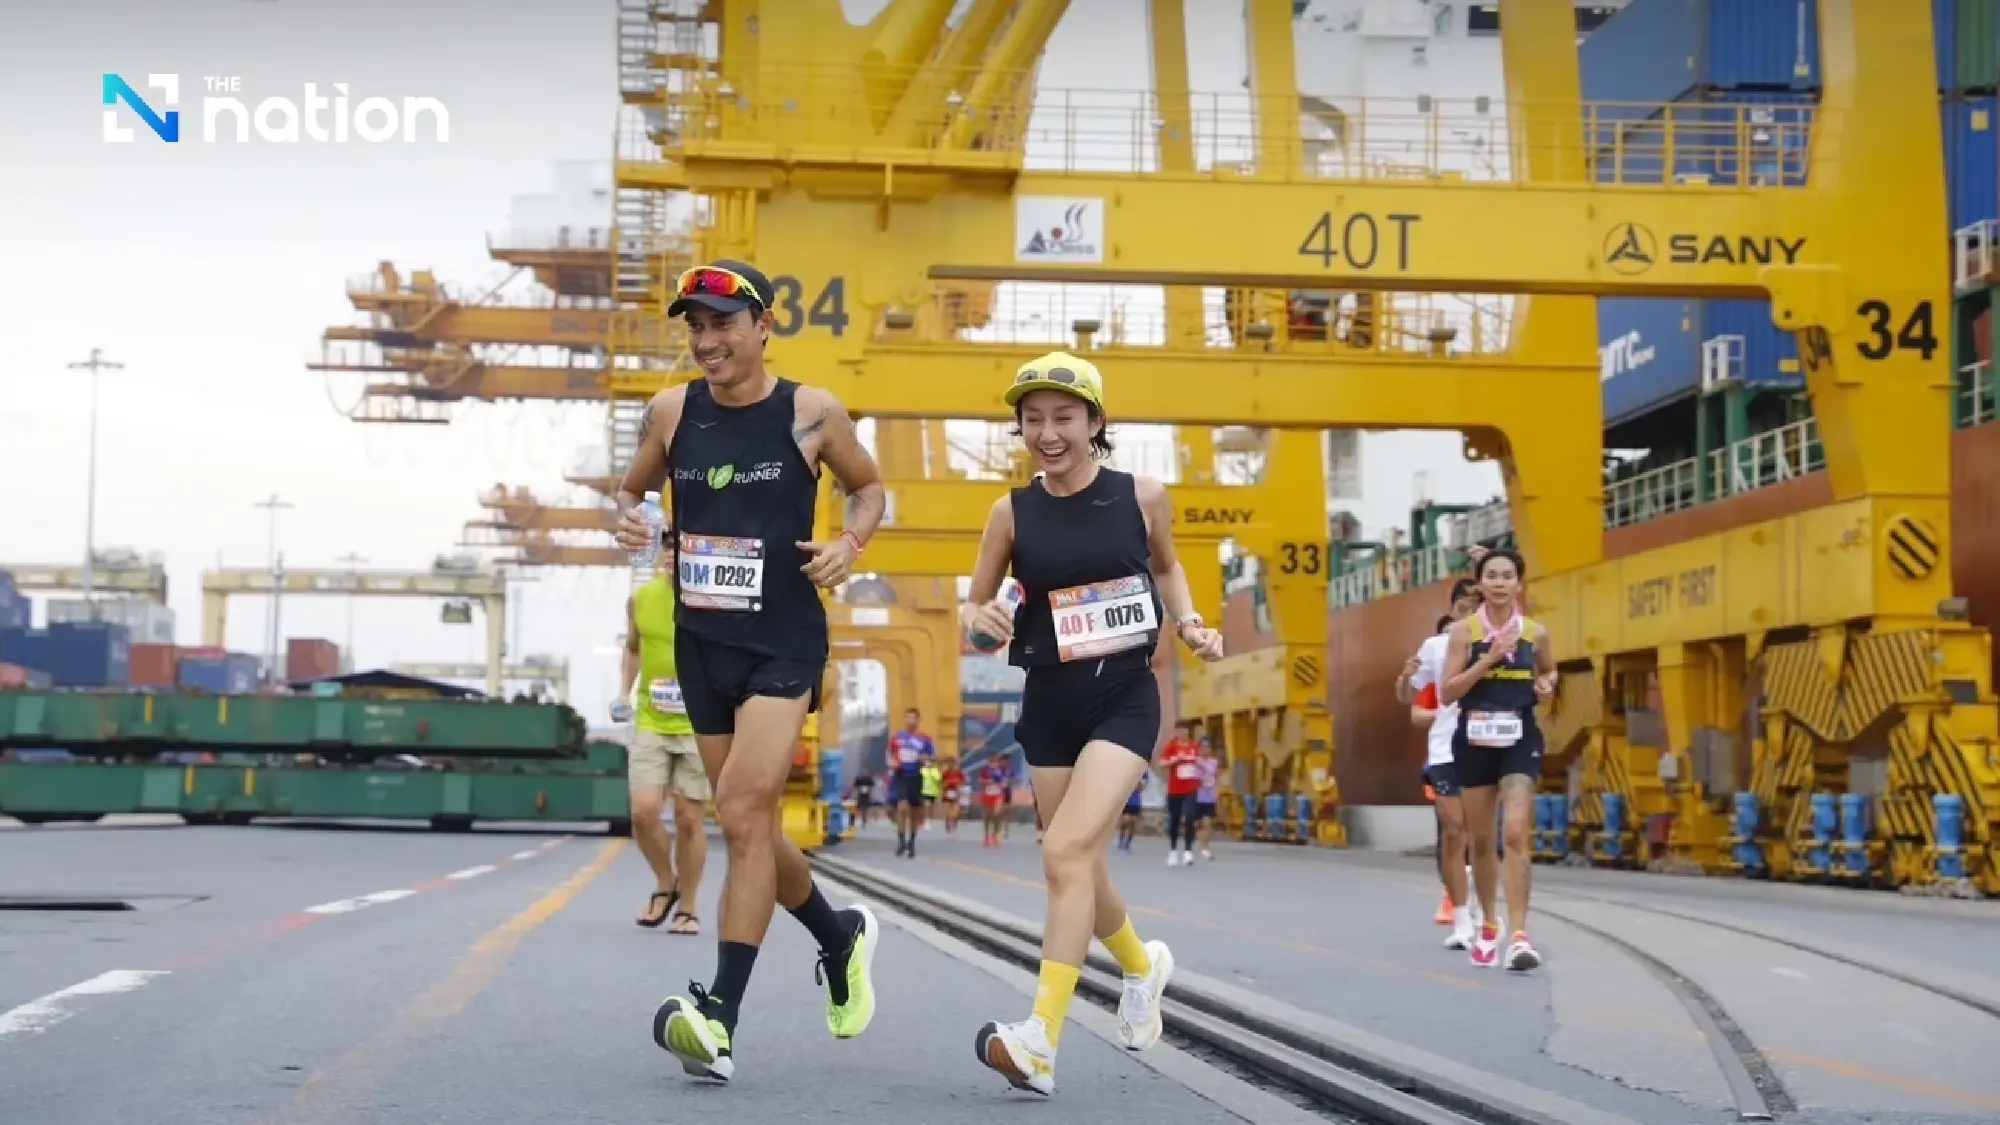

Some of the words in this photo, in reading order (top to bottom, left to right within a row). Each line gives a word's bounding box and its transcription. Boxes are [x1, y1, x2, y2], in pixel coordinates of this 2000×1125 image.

[1298, 211, 1422, 271] 40T
[1668, 234, 1808, 265] SANY
[770, 276, 849, 337] 34
[1857, 299, 1938, 361] 34
[734, 467, 781, 484] RUNNER
[1184, 507, 1254, 525] SANY
[1280, 542, 1320, 575] 33
[693, 563, 709, 586] M
[714, 565, 756, 588] 0292
[1627, 577, 1674, 620] SAFETY
[1680, 565, 1716, 611] FIRST
[1060, 613, 1083, 636] 40
[1085, 612, 1095, 634] F
[1104, 602, 1146, 629] 0176
